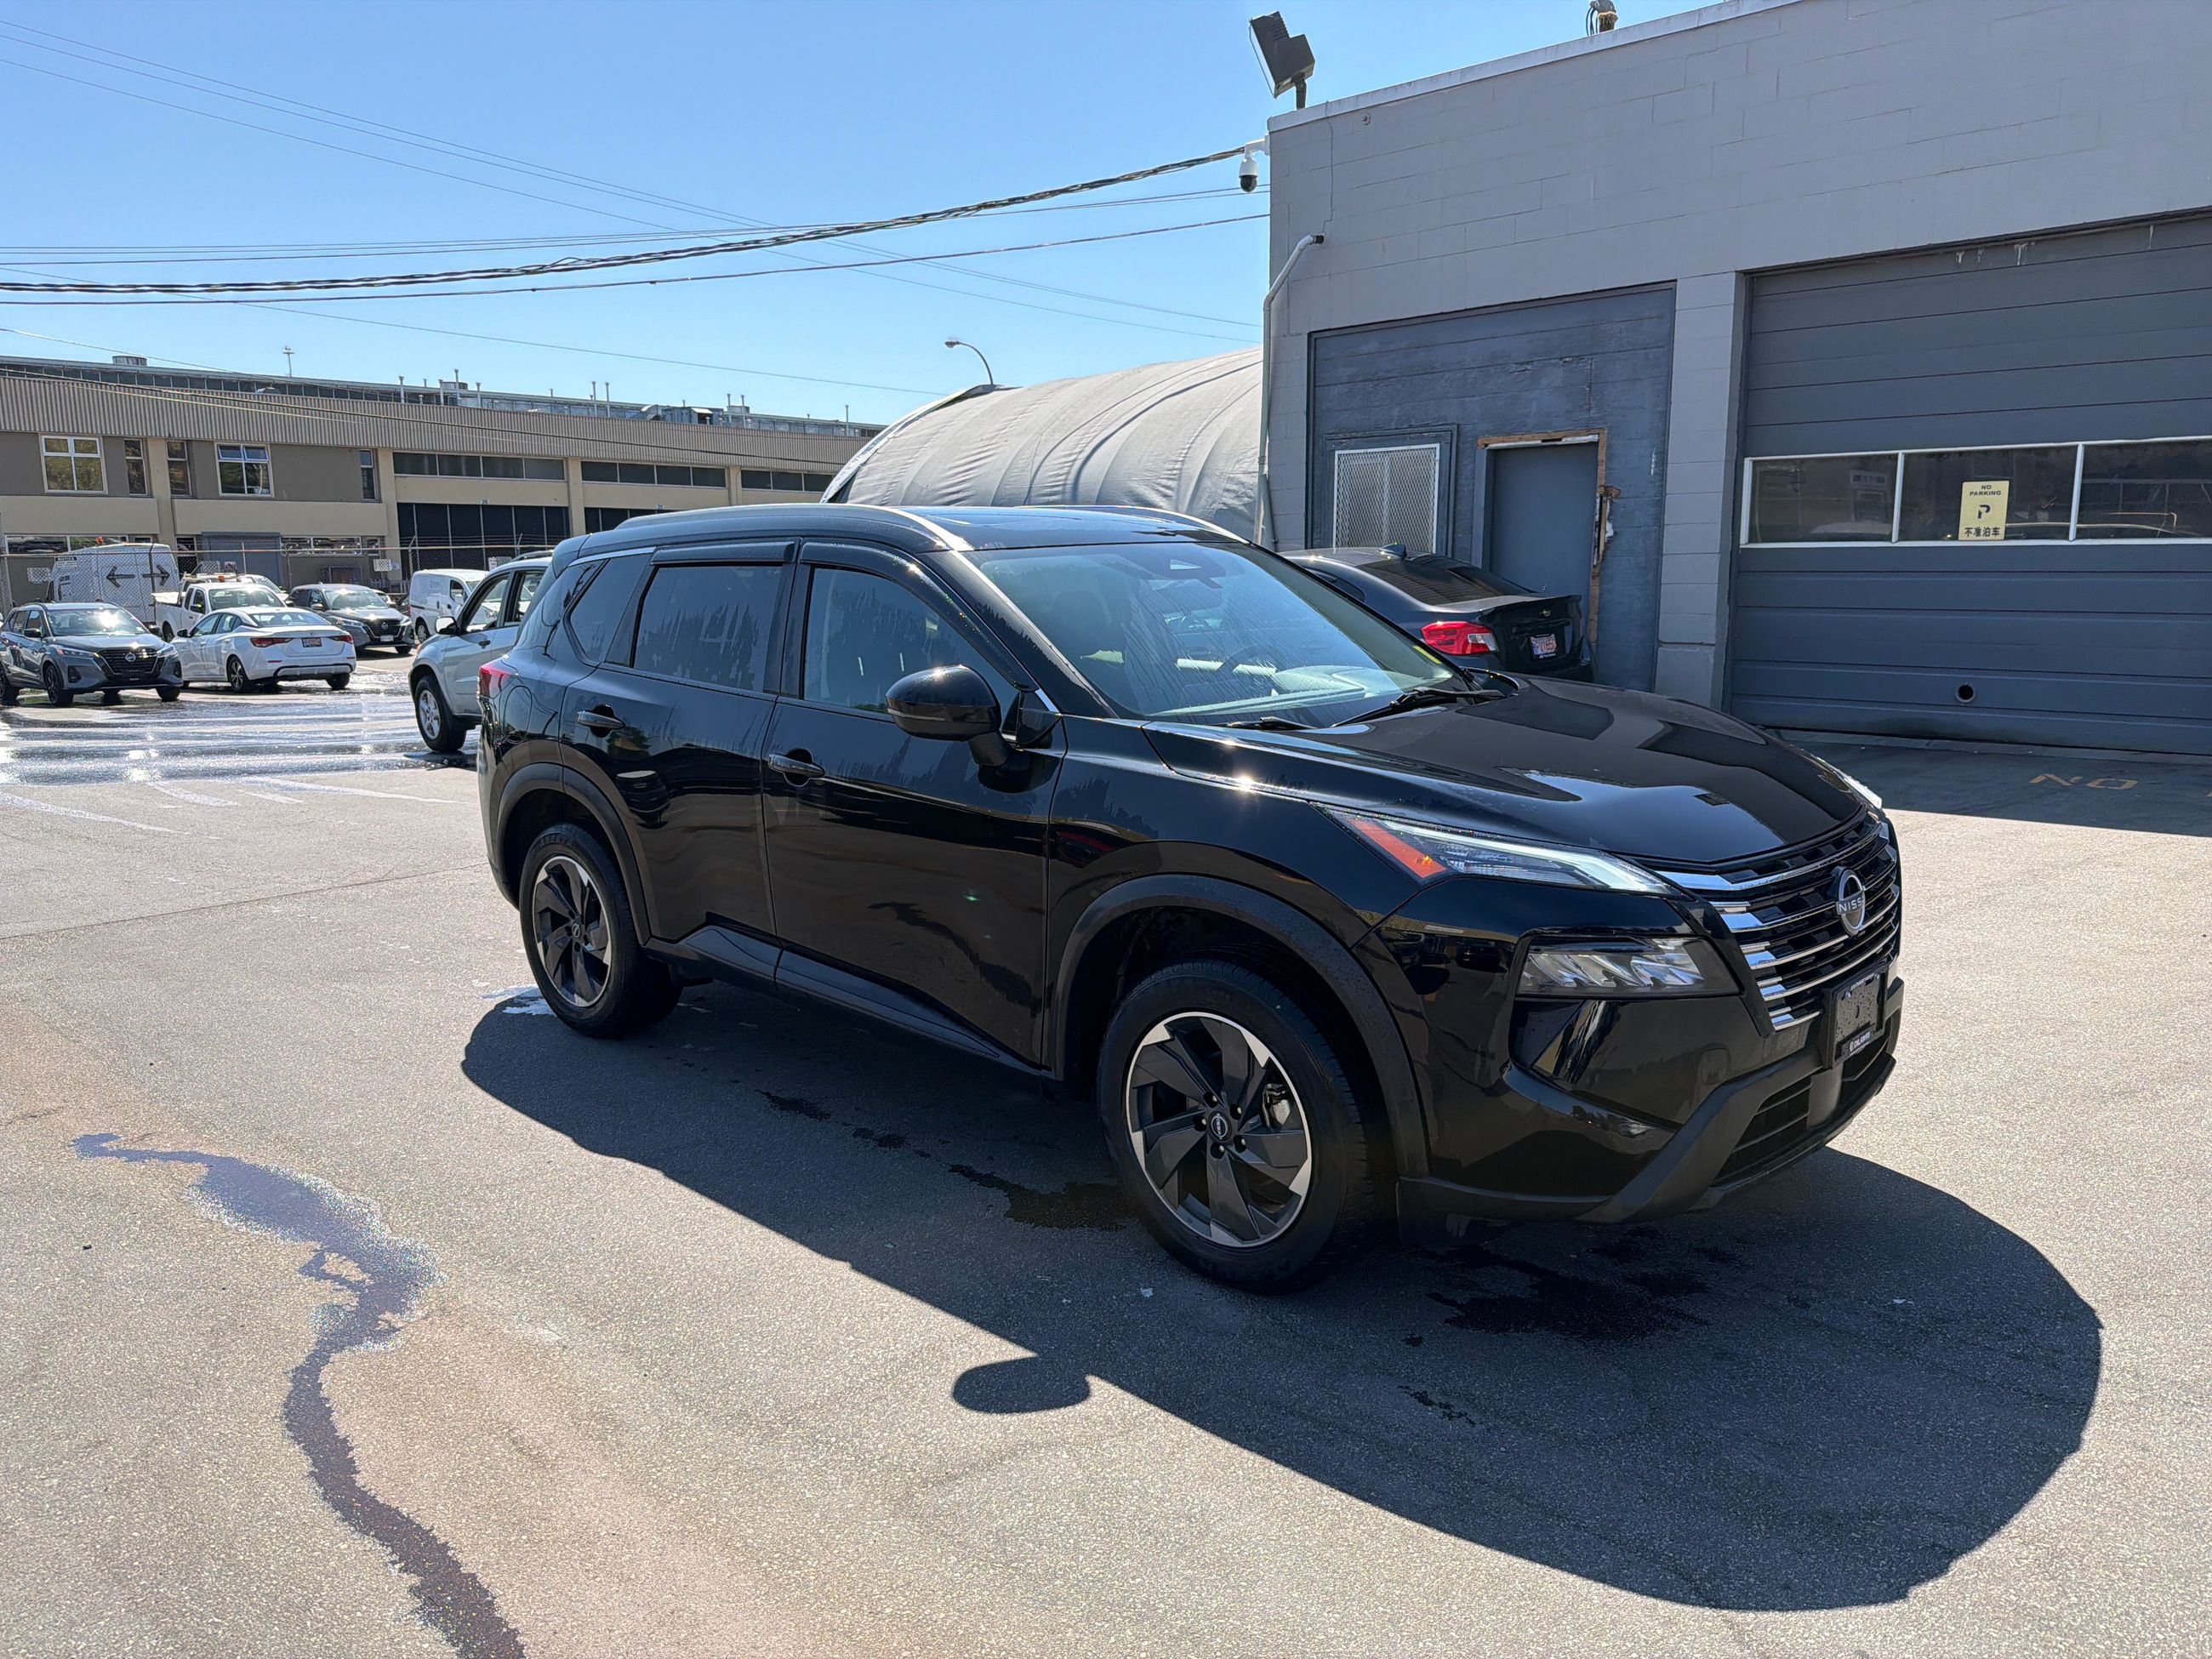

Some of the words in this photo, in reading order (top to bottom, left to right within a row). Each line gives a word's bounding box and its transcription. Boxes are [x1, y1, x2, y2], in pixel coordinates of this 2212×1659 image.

[1964, 526, 2000, 538] 不准泊车
[2028, 773, 2138, 790] NO
[1839, 897, 1863, 913] NISS
